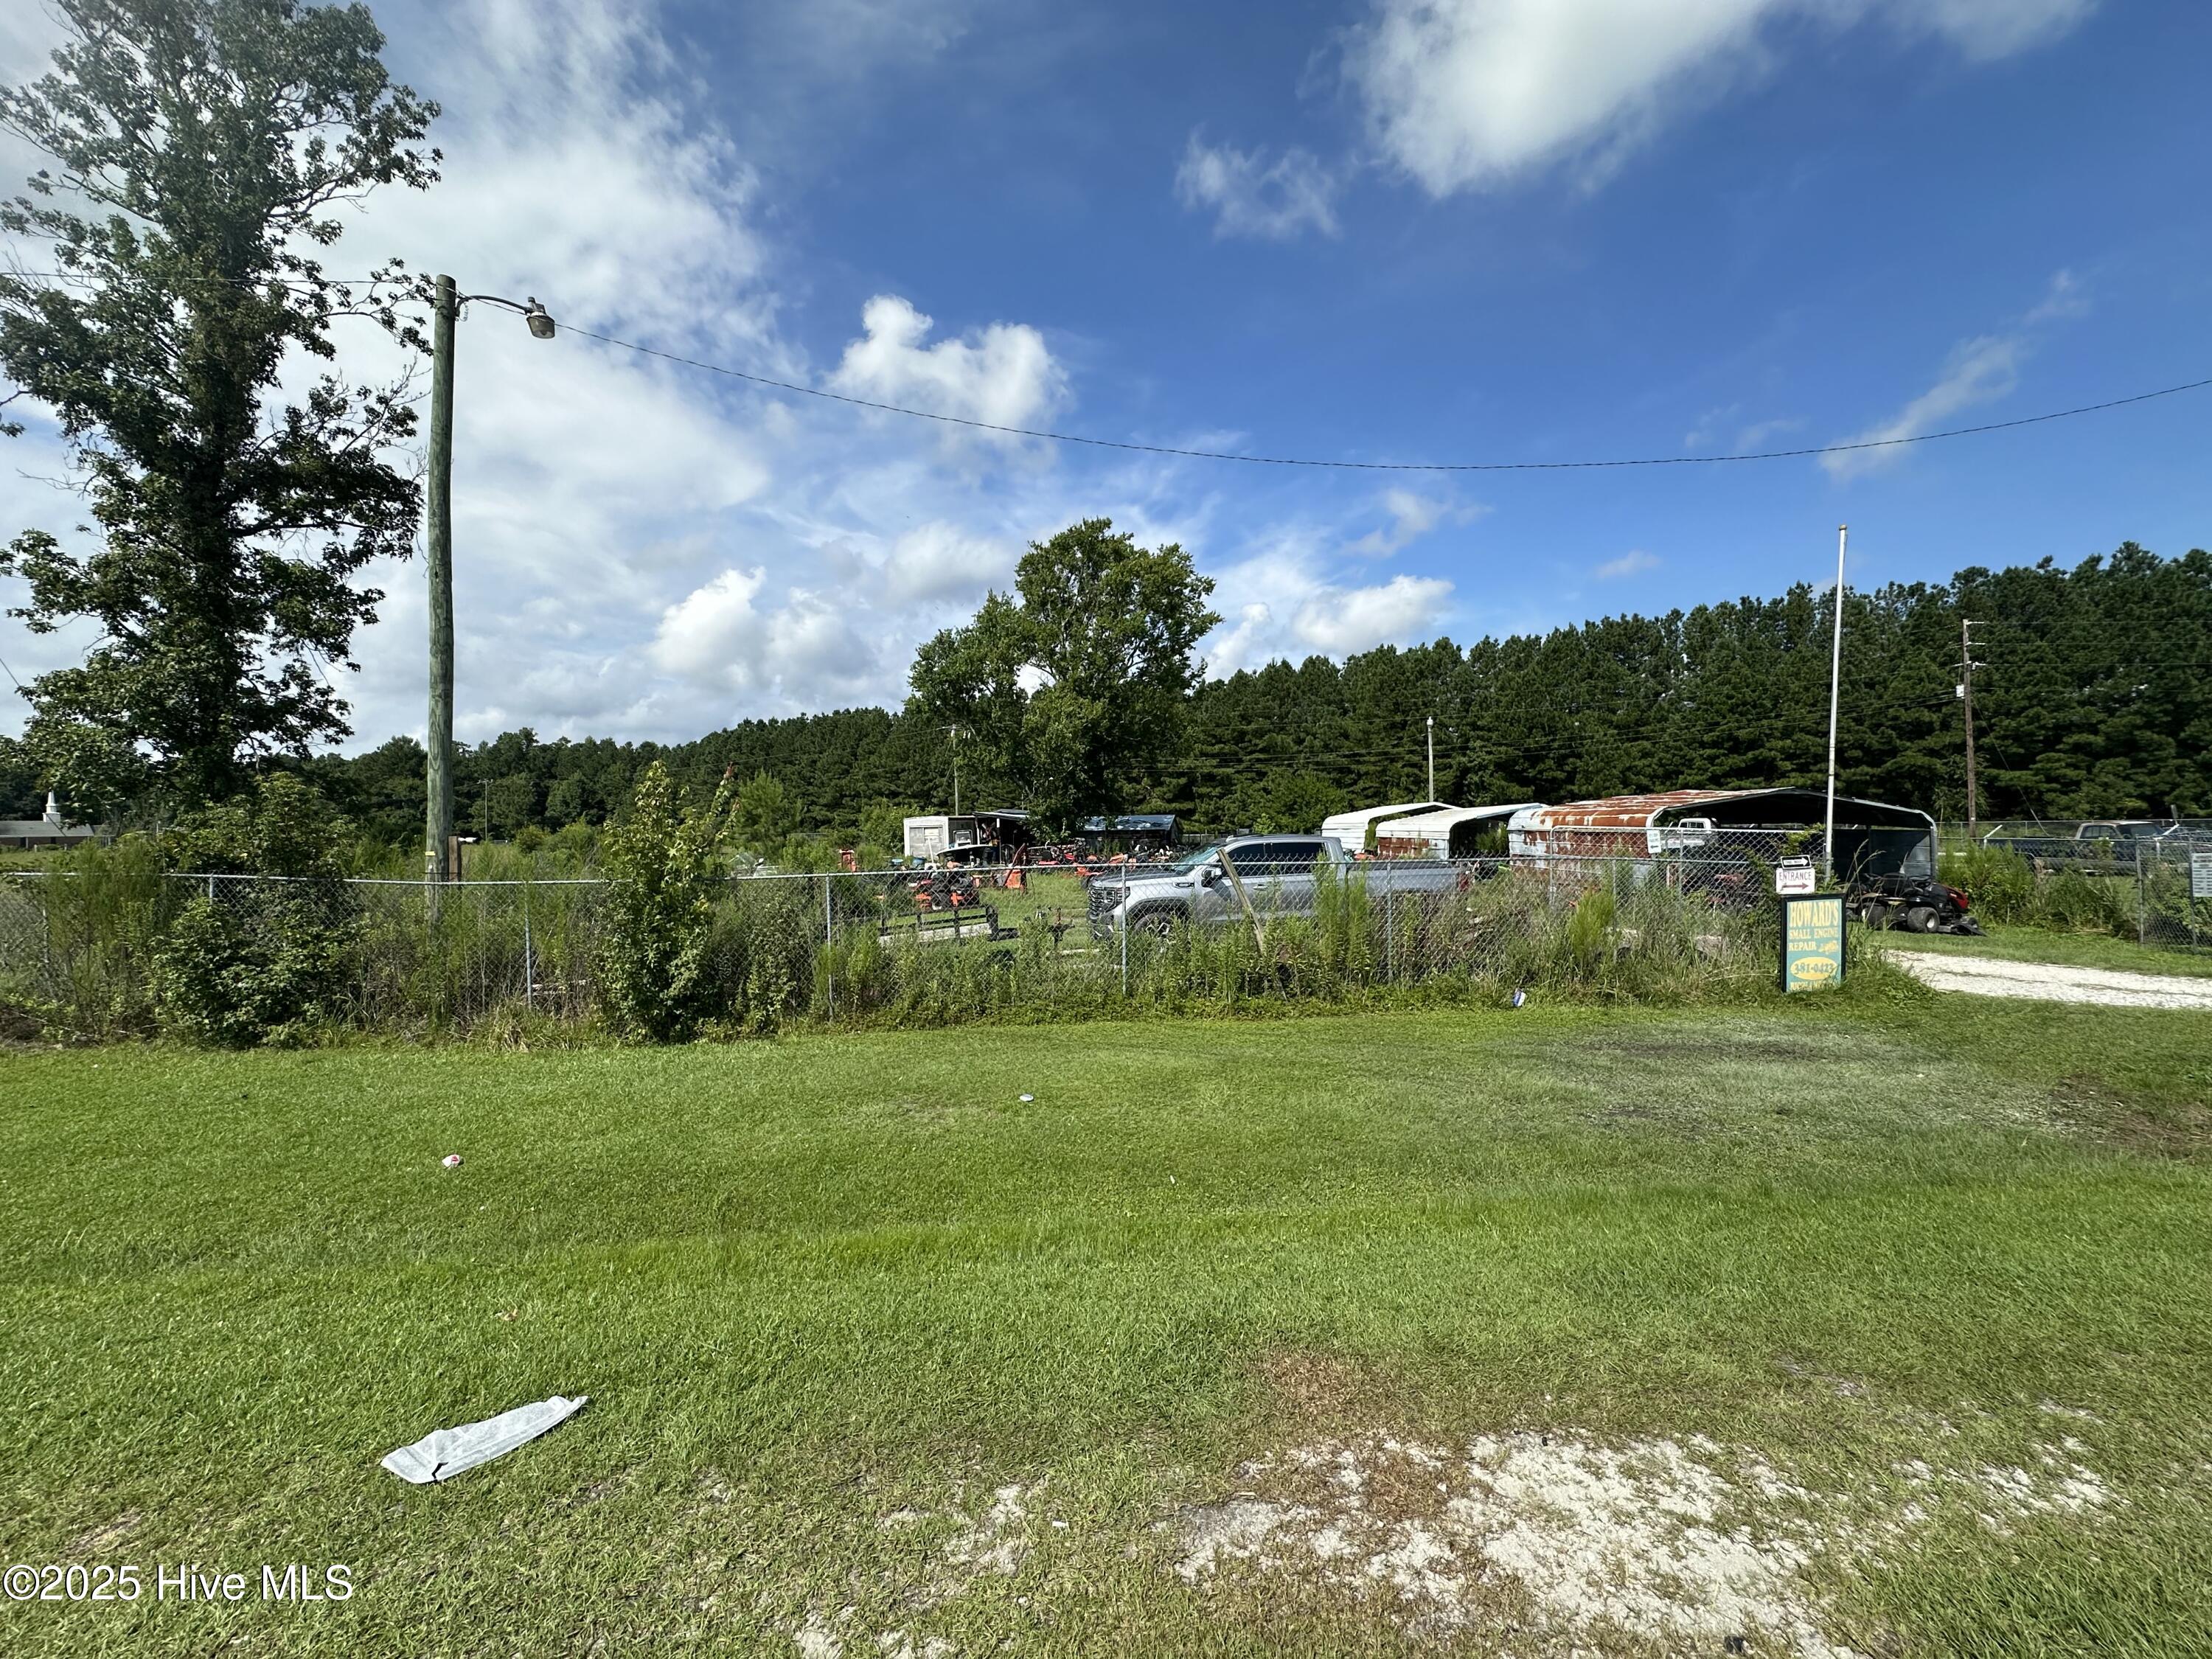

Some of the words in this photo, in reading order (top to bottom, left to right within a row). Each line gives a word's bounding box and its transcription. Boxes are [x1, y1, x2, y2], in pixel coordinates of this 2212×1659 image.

[1778, 872, 1812, 881] ENTRANCE
[1790, 900, 1839, 928] HOWARD'S
[1789, 928, 1812, 939] SMALL
[1814, 927, 1839, 939] ENGINE
[1788, 941, 1817, 951] REPAIR
